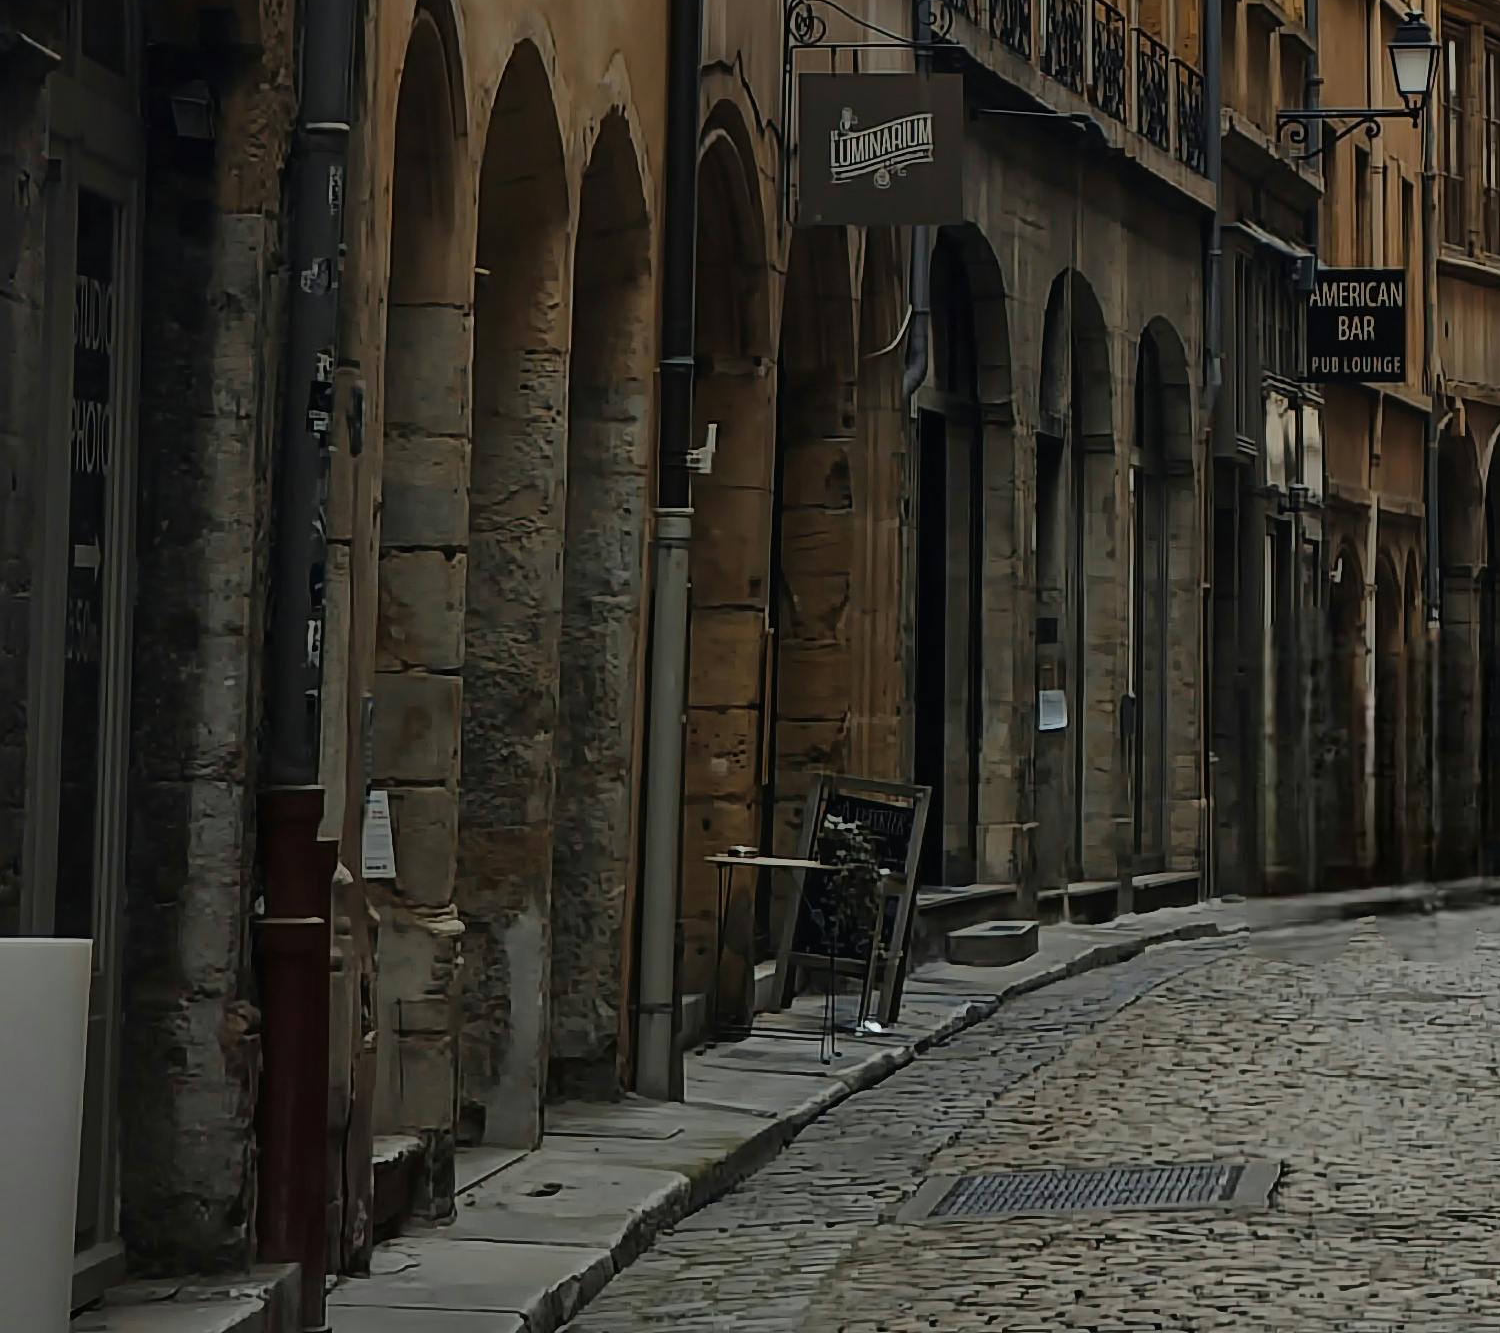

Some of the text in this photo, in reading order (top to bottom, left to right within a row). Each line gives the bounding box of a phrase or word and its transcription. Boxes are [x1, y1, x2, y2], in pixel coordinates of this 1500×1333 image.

[830, 117, 934, 167] LUMINARIUM
[1309, 281, 1403, 307] AMERICAN
[1338, 315, 1376, 342] BAR
[1343, 355, 1401, 374] LOUNGE
